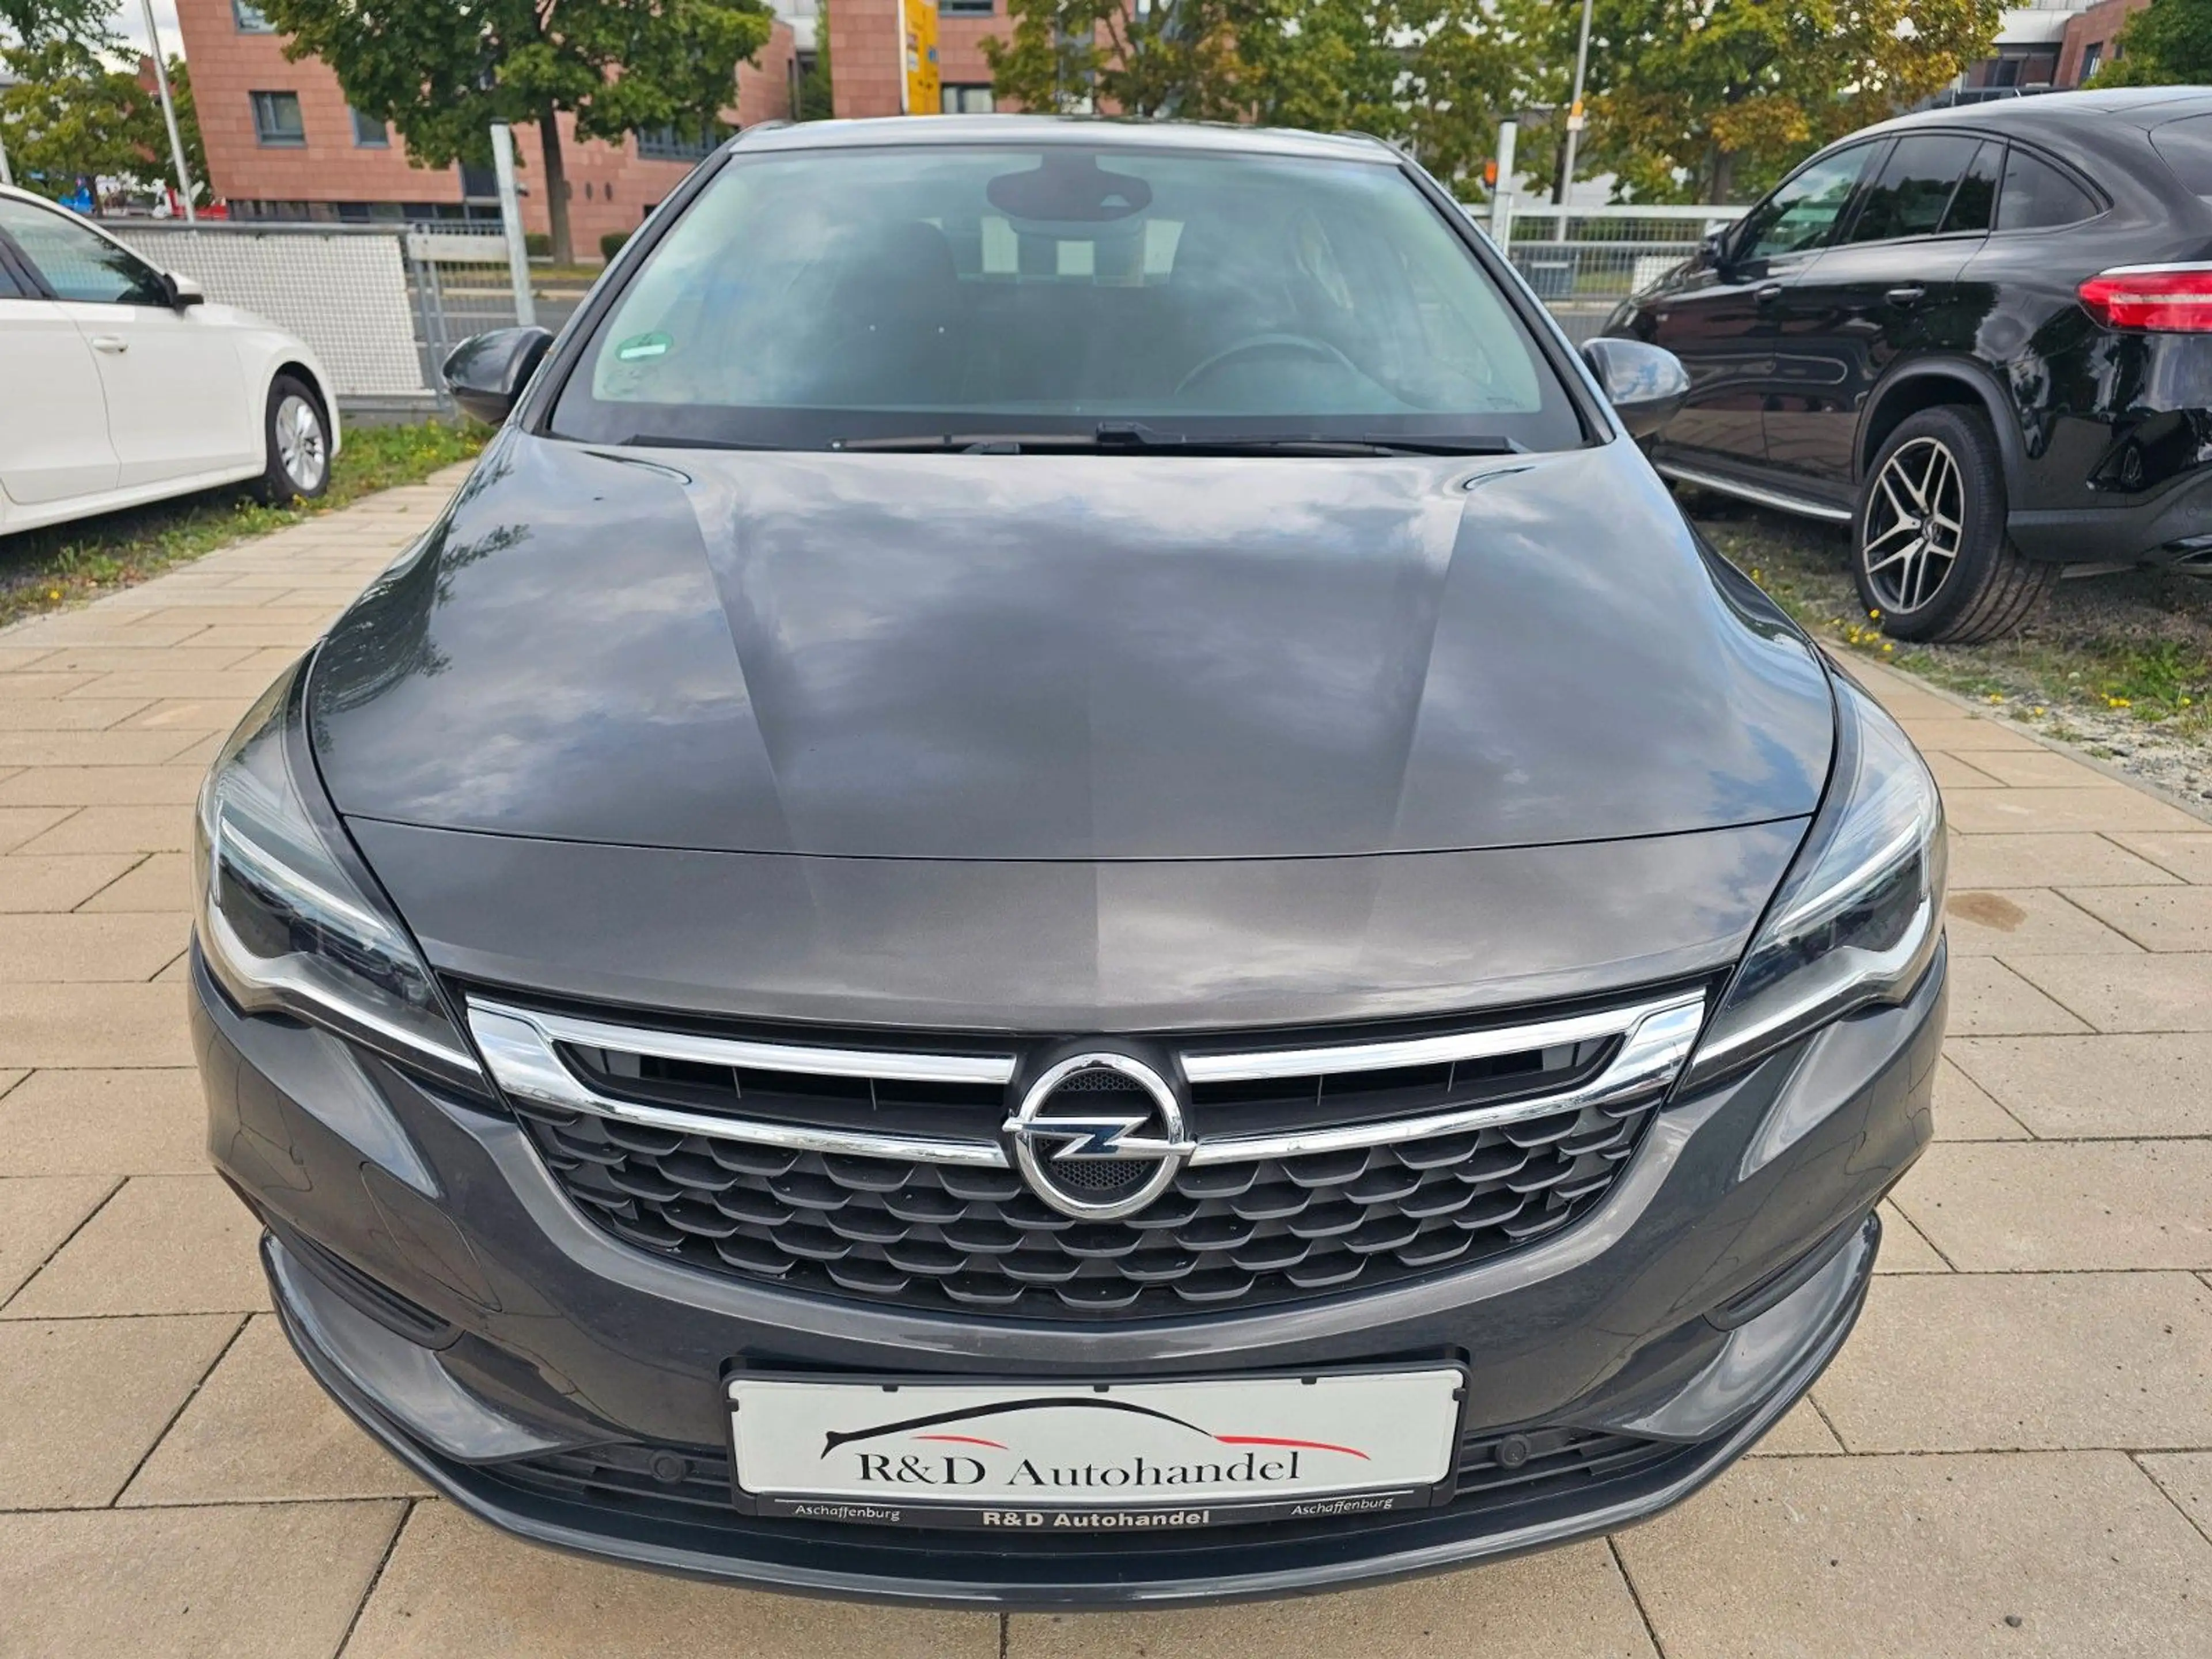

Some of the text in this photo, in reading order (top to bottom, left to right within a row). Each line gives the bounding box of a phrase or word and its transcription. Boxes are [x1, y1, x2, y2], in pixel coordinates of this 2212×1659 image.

[856, 1451, 1300, 1486] R&D Autohandel
[795, 1505, 900, 1521] Aschaffenburg
[1291, 1498, 1394, 1516] Aschaffenburg
[983, 1510, 1209, 1526] R&D Autohandel
